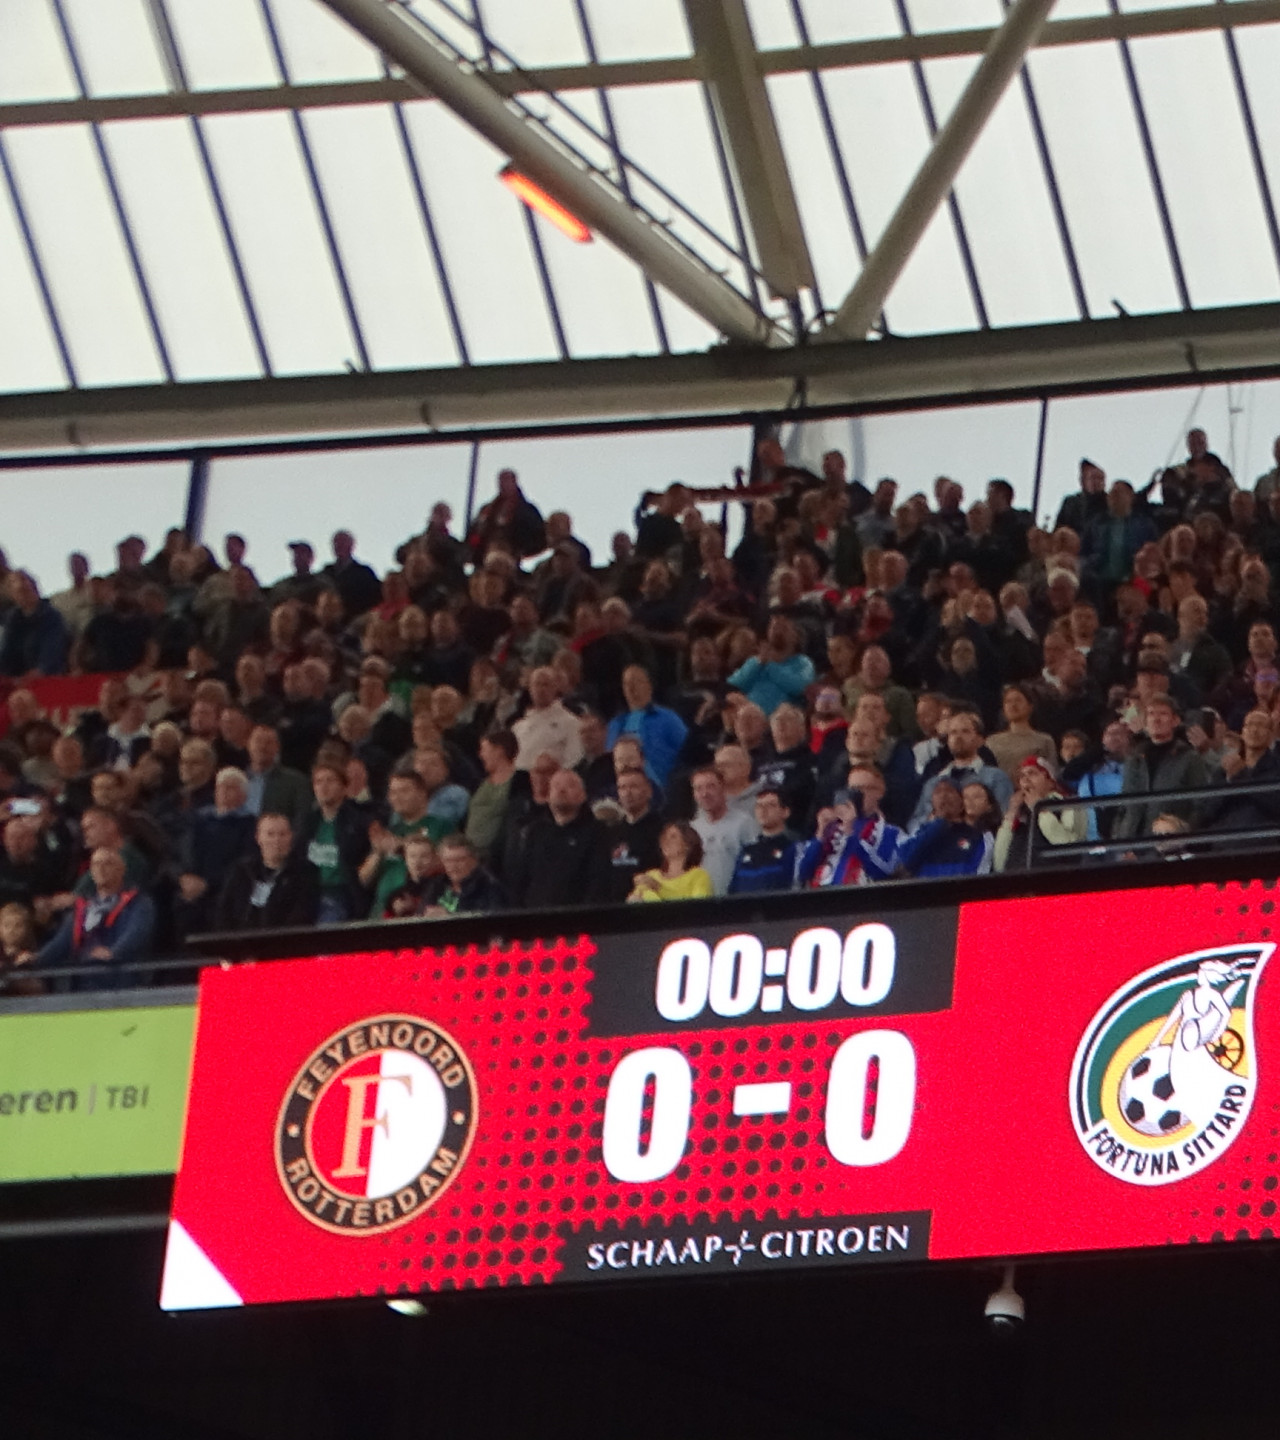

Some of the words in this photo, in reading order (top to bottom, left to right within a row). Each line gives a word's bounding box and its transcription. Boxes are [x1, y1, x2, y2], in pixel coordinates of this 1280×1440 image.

[656, 922, 896, 1022] 00:00
[0, 1088, 78, 1115] eren
[106, 1085, 149, 1110] TBI
[296, 1023, 466, 1101] FEYENOORD
[602, 1047, 692, 1183] 0
[825, 1029, 916, 1167] 0
[1087, 1127, 1180, 1176] FORTUNA
[1184, 1084, 1247, 1165] SITTARD
[287, 1147, 458, 1226] ROTTERDAM
[586, 1235, 723, 1271] SCHAAP
[761, 1224, 910, 1260] CITROEN
